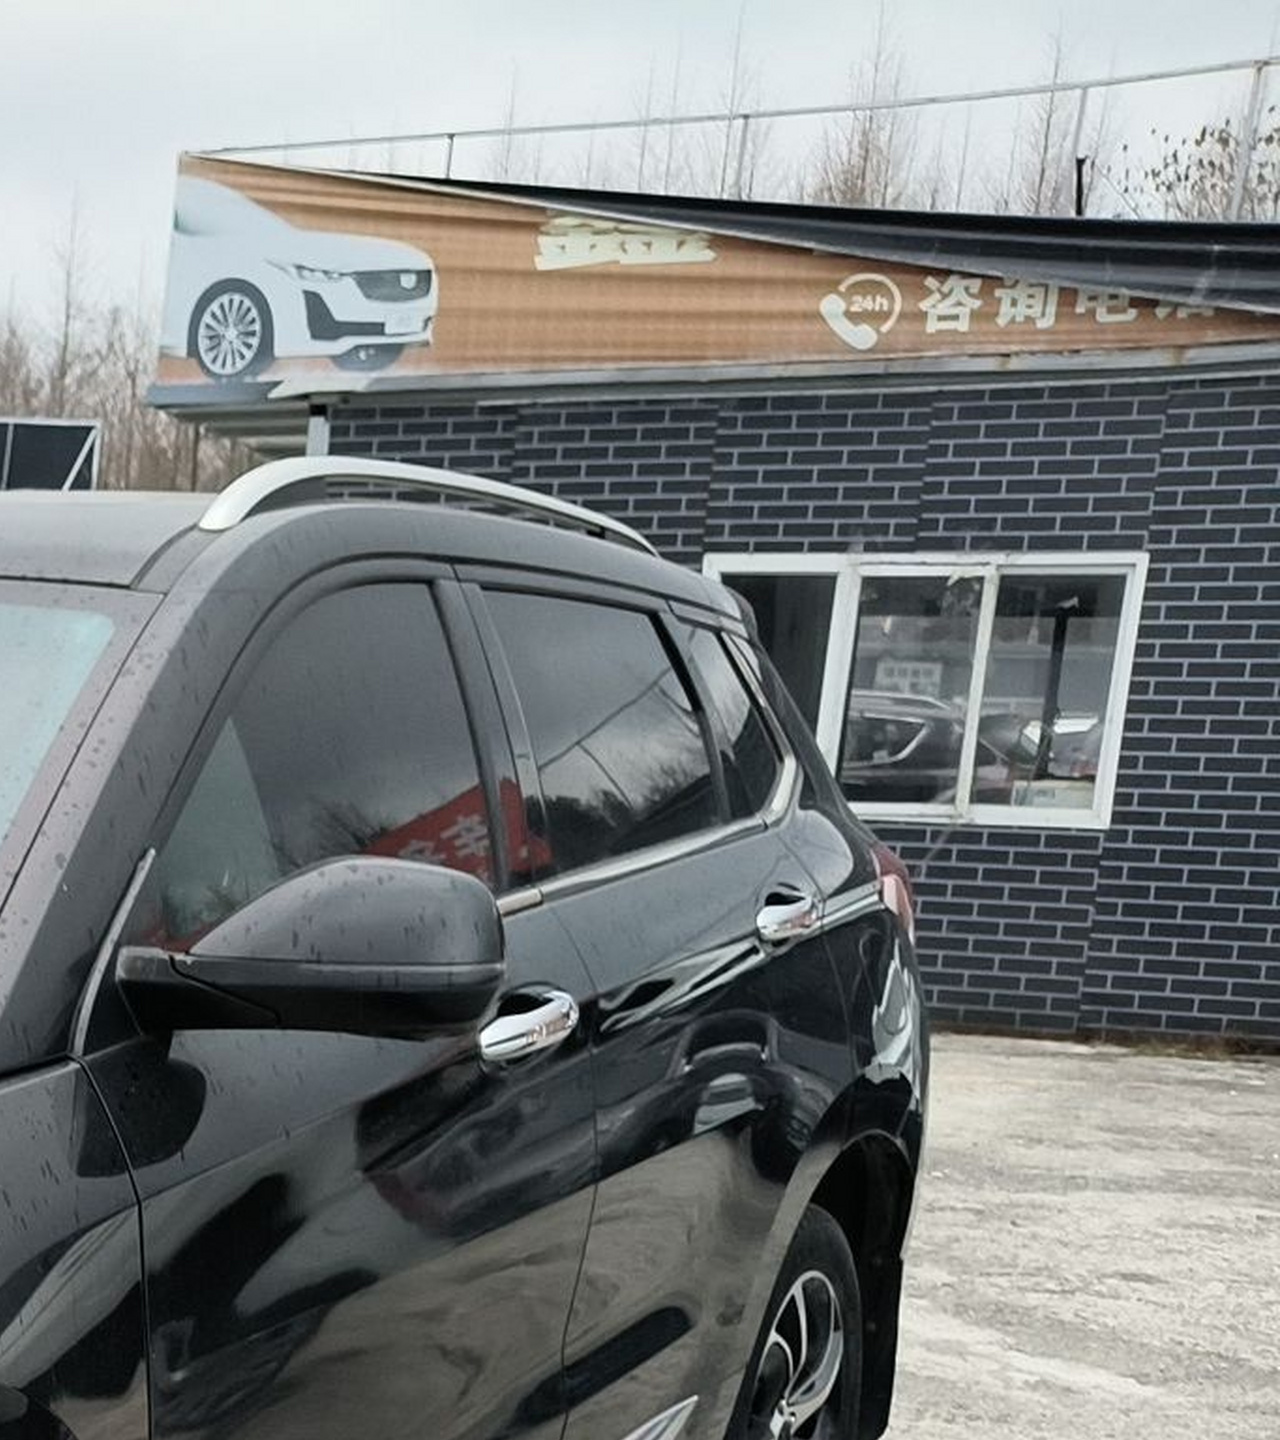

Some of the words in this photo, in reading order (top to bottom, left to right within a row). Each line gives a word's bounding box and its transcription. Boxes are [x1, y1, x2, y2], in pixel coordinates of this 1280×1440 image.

[849, 294, 889, 312] 24h
[918, 274, 1215, 333] 咨询电
